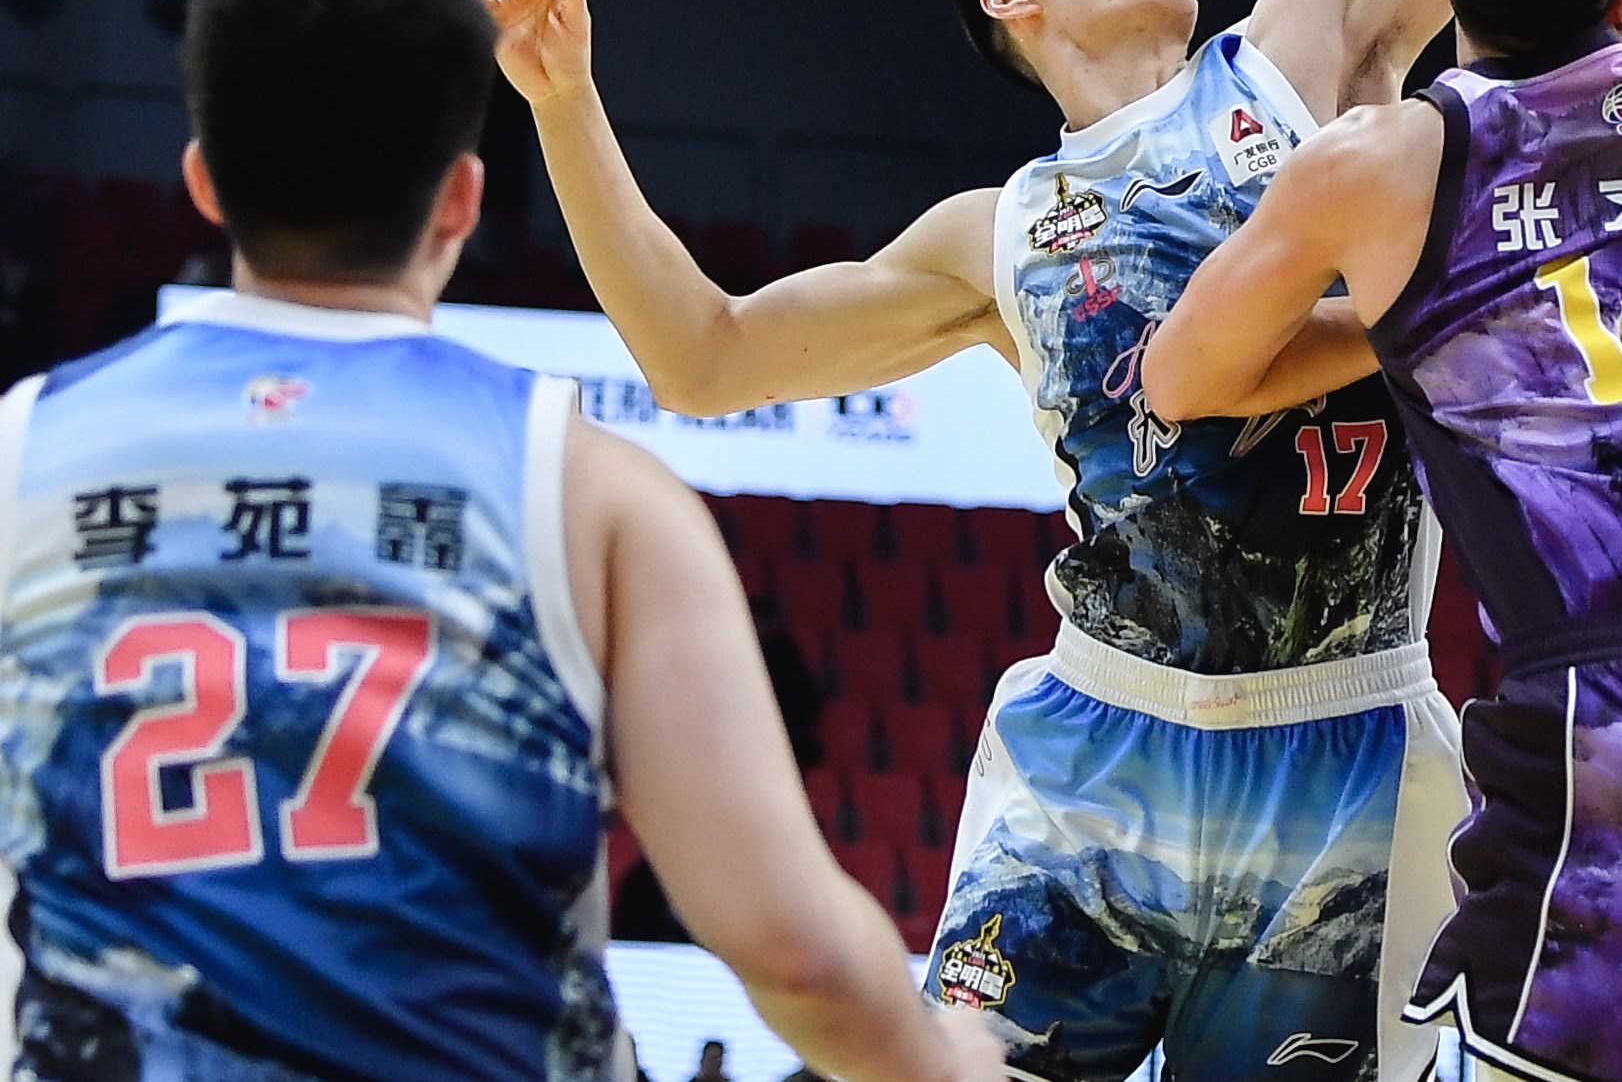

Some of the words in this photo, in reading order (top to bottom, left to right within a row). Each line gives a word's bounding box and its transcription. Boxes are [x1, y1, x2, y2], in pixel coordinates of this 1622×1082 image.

[1247, 154, 1277, 172] CGB
[1296, 419, 1387, 515] 17
[94, 606, 440, 880] 27
